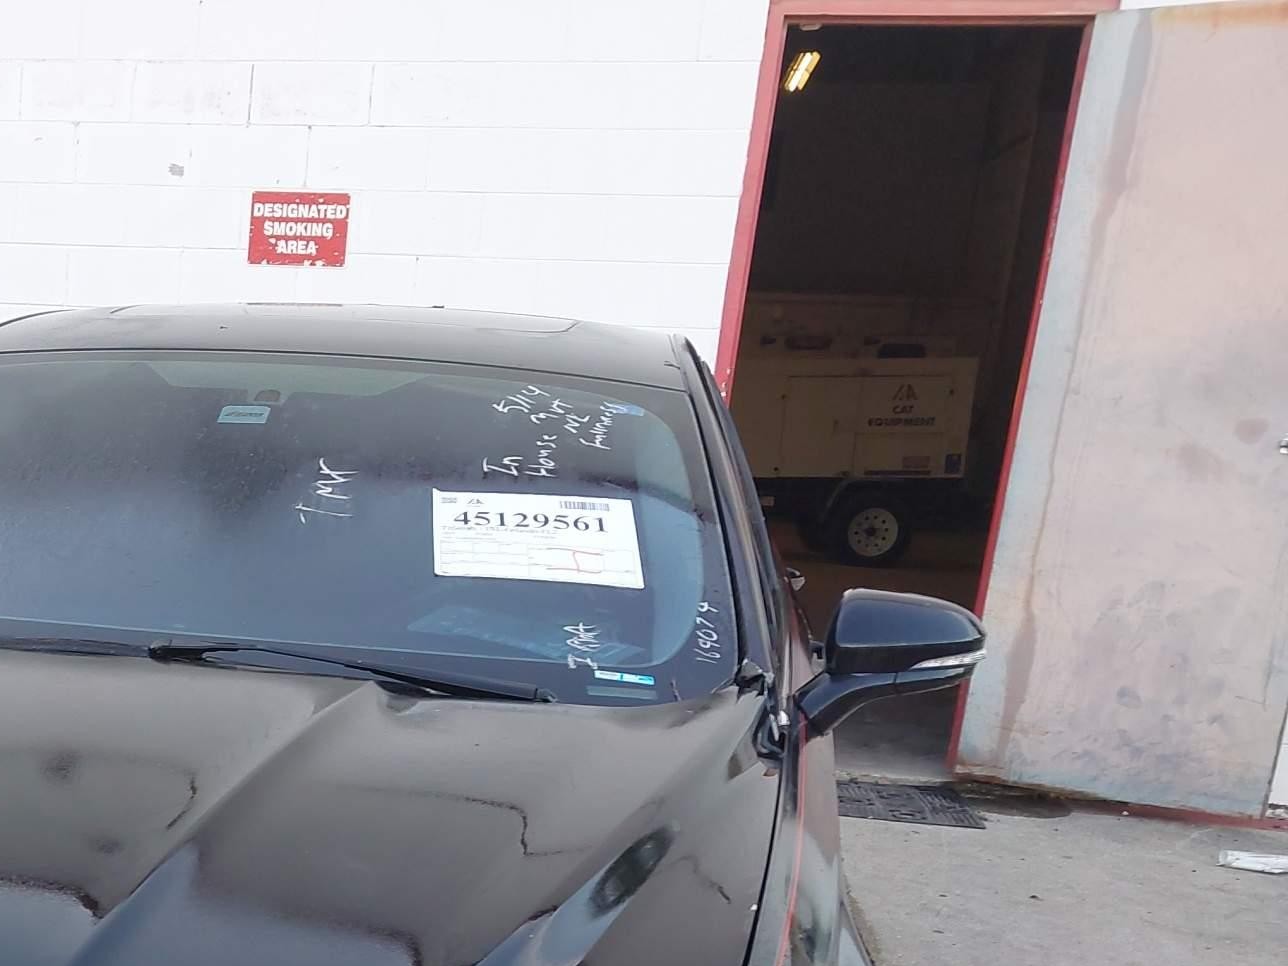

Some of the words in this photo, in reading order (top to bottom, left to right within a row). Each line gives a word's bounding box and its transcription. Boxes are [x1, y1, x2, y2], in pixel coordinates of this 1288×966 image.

[253, 202, 348, 219] DESIGNATED
[263, 220, 334, 238] SMOKING
[275, 239, 317, 256] AREA
[453, 511, 609, 534] 45129561
